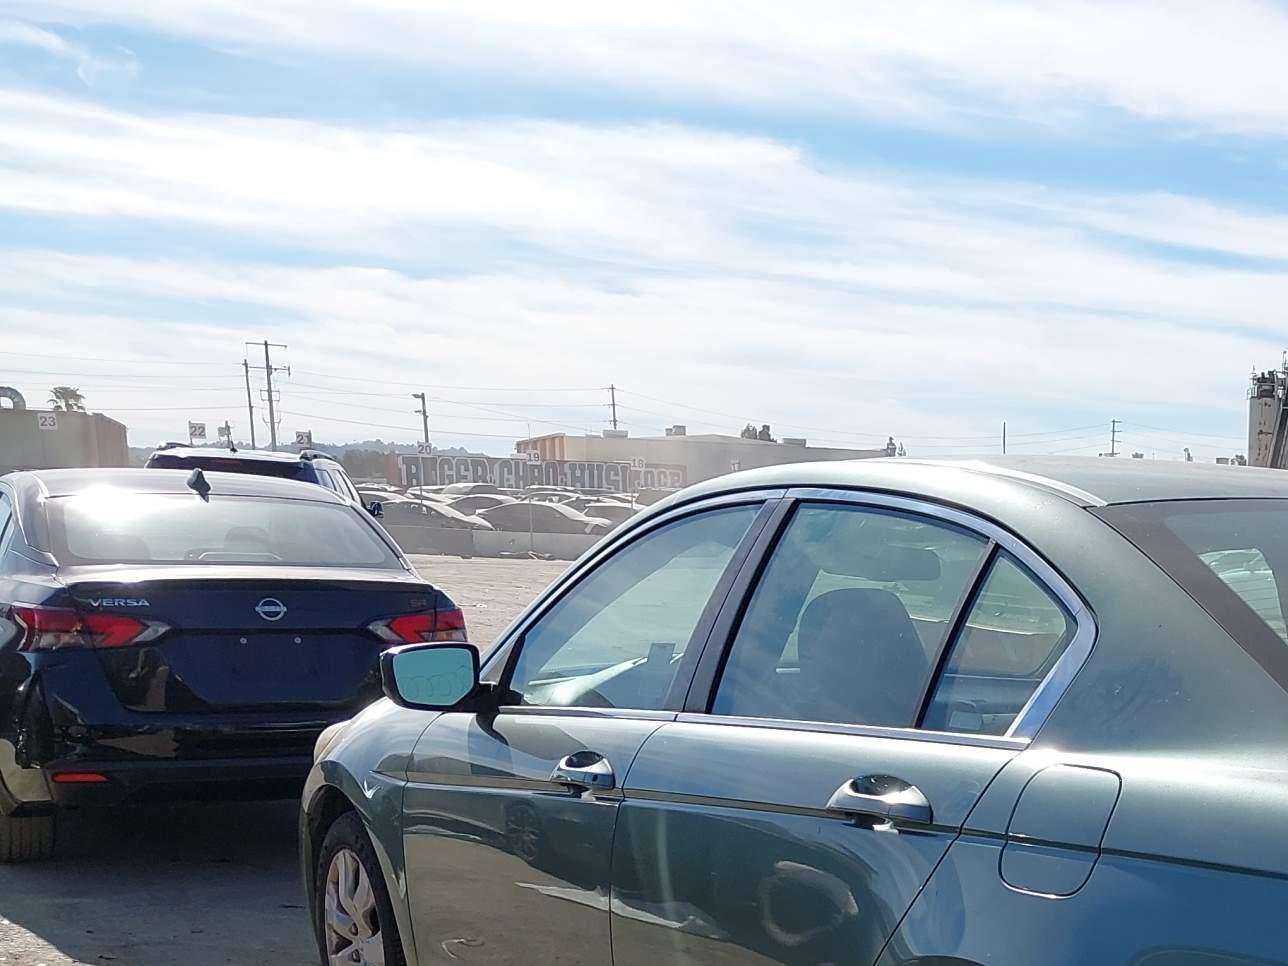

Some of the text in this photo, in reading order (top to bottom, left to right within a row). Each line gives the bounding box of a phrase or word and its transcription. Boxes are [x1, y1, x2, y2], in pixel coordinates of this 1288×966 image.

[40, 416, 56, 426] 23
[190, 426, 206, 436] 22
[418, 444, 432, 455] 20
[528, 453, 539, 461] 19
[89, 599, 150, 607] VERSA
